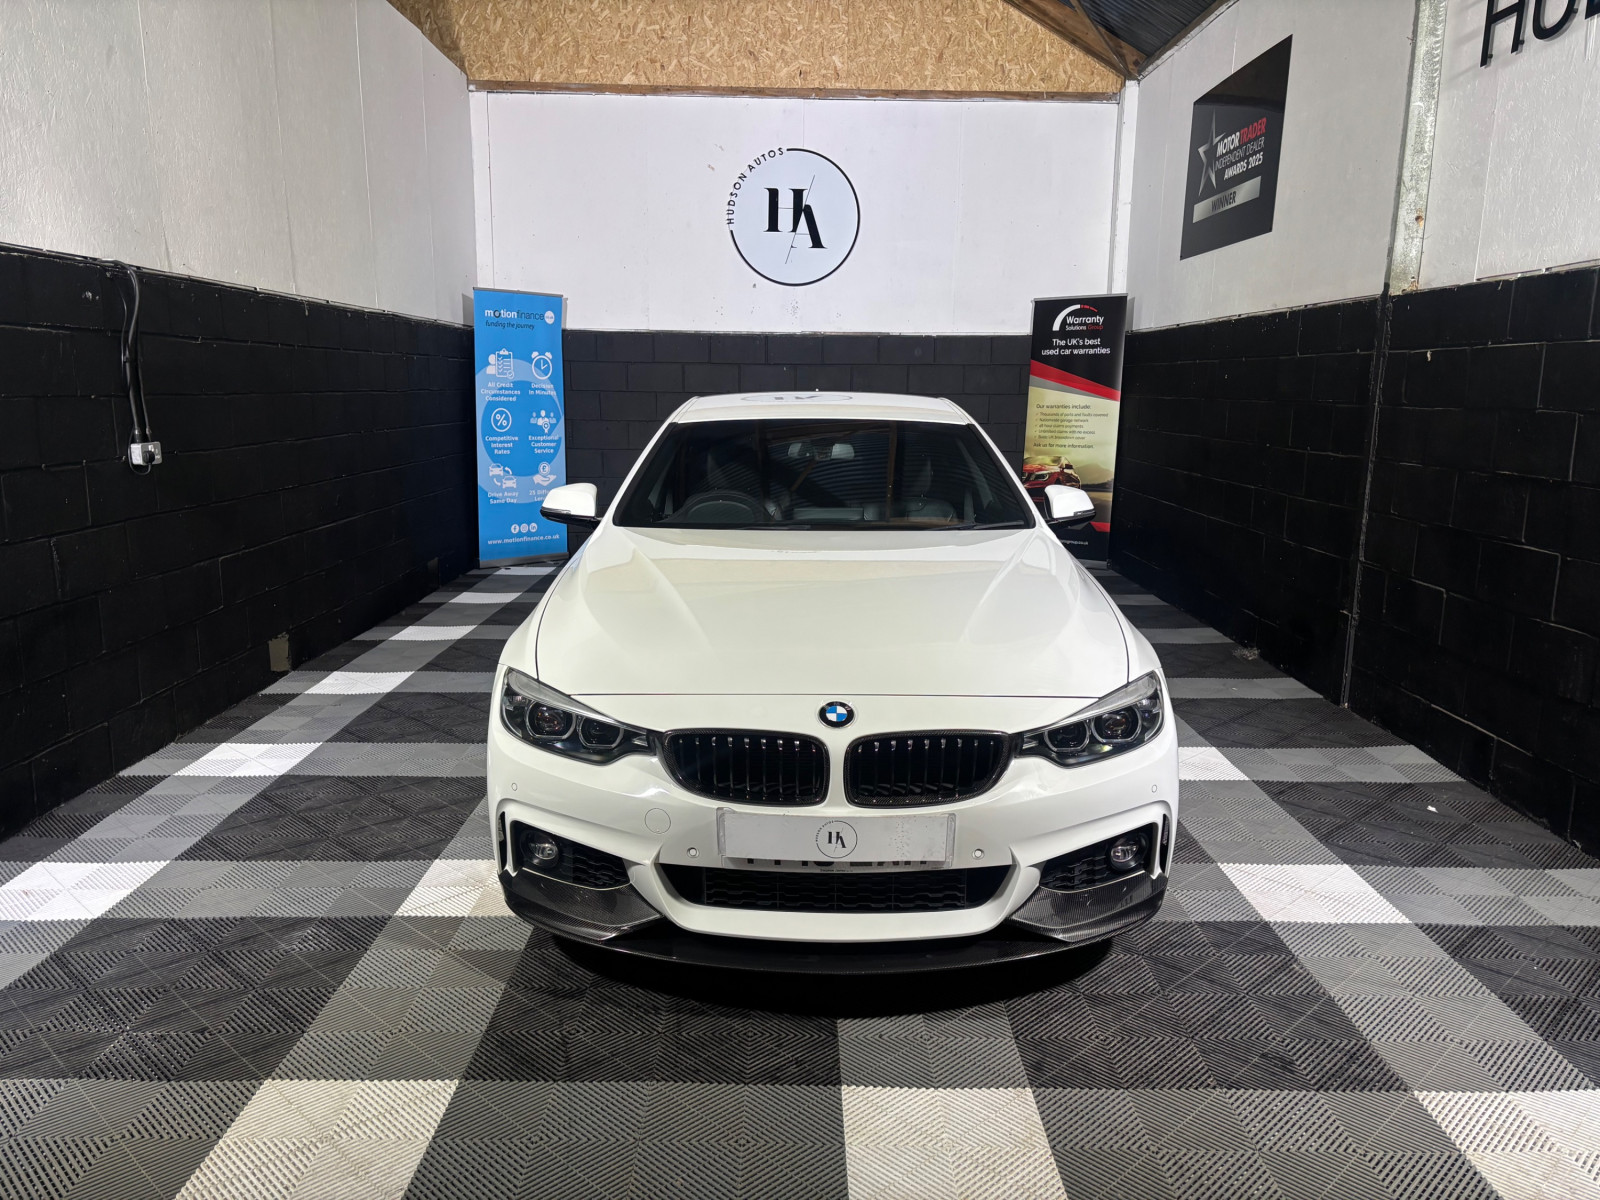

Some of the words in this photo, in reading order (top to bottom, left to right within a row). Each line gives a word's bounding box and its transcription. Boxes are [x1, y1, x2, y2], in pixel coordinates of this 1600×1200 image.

[1480, 0, 1600, 68] HU
[1215, 145, 1246, 171] INDEPENDENT
[1246, 136, 1264, 156] DEALER
[1223, 159, 1247, 180] AWARDS
[1248, 152, 1264, 169] 2025
[726, 172, 747, 225] HUDSON
[747, 147, 784, 173] AUTOS
[1211, 191, 1237, 213] WINNER
[485, 320, 506, 330] funding
[506, 321, 515, 329] the
[515, 322, 535, 331] journey
[1066, 315, 1104, 326] Warranty
[1052, 338, 1066, 346] The
[1067, 338, 1083, 346] UK's
[1084, 337, 1101, 345] best
[1041, 347, 1059, 355] used
[1072, 346, 1111, 354] warranties
[503, 490, 519, 498] Away
[487, 534, 560, 546] www.motionfinance.co.uk
